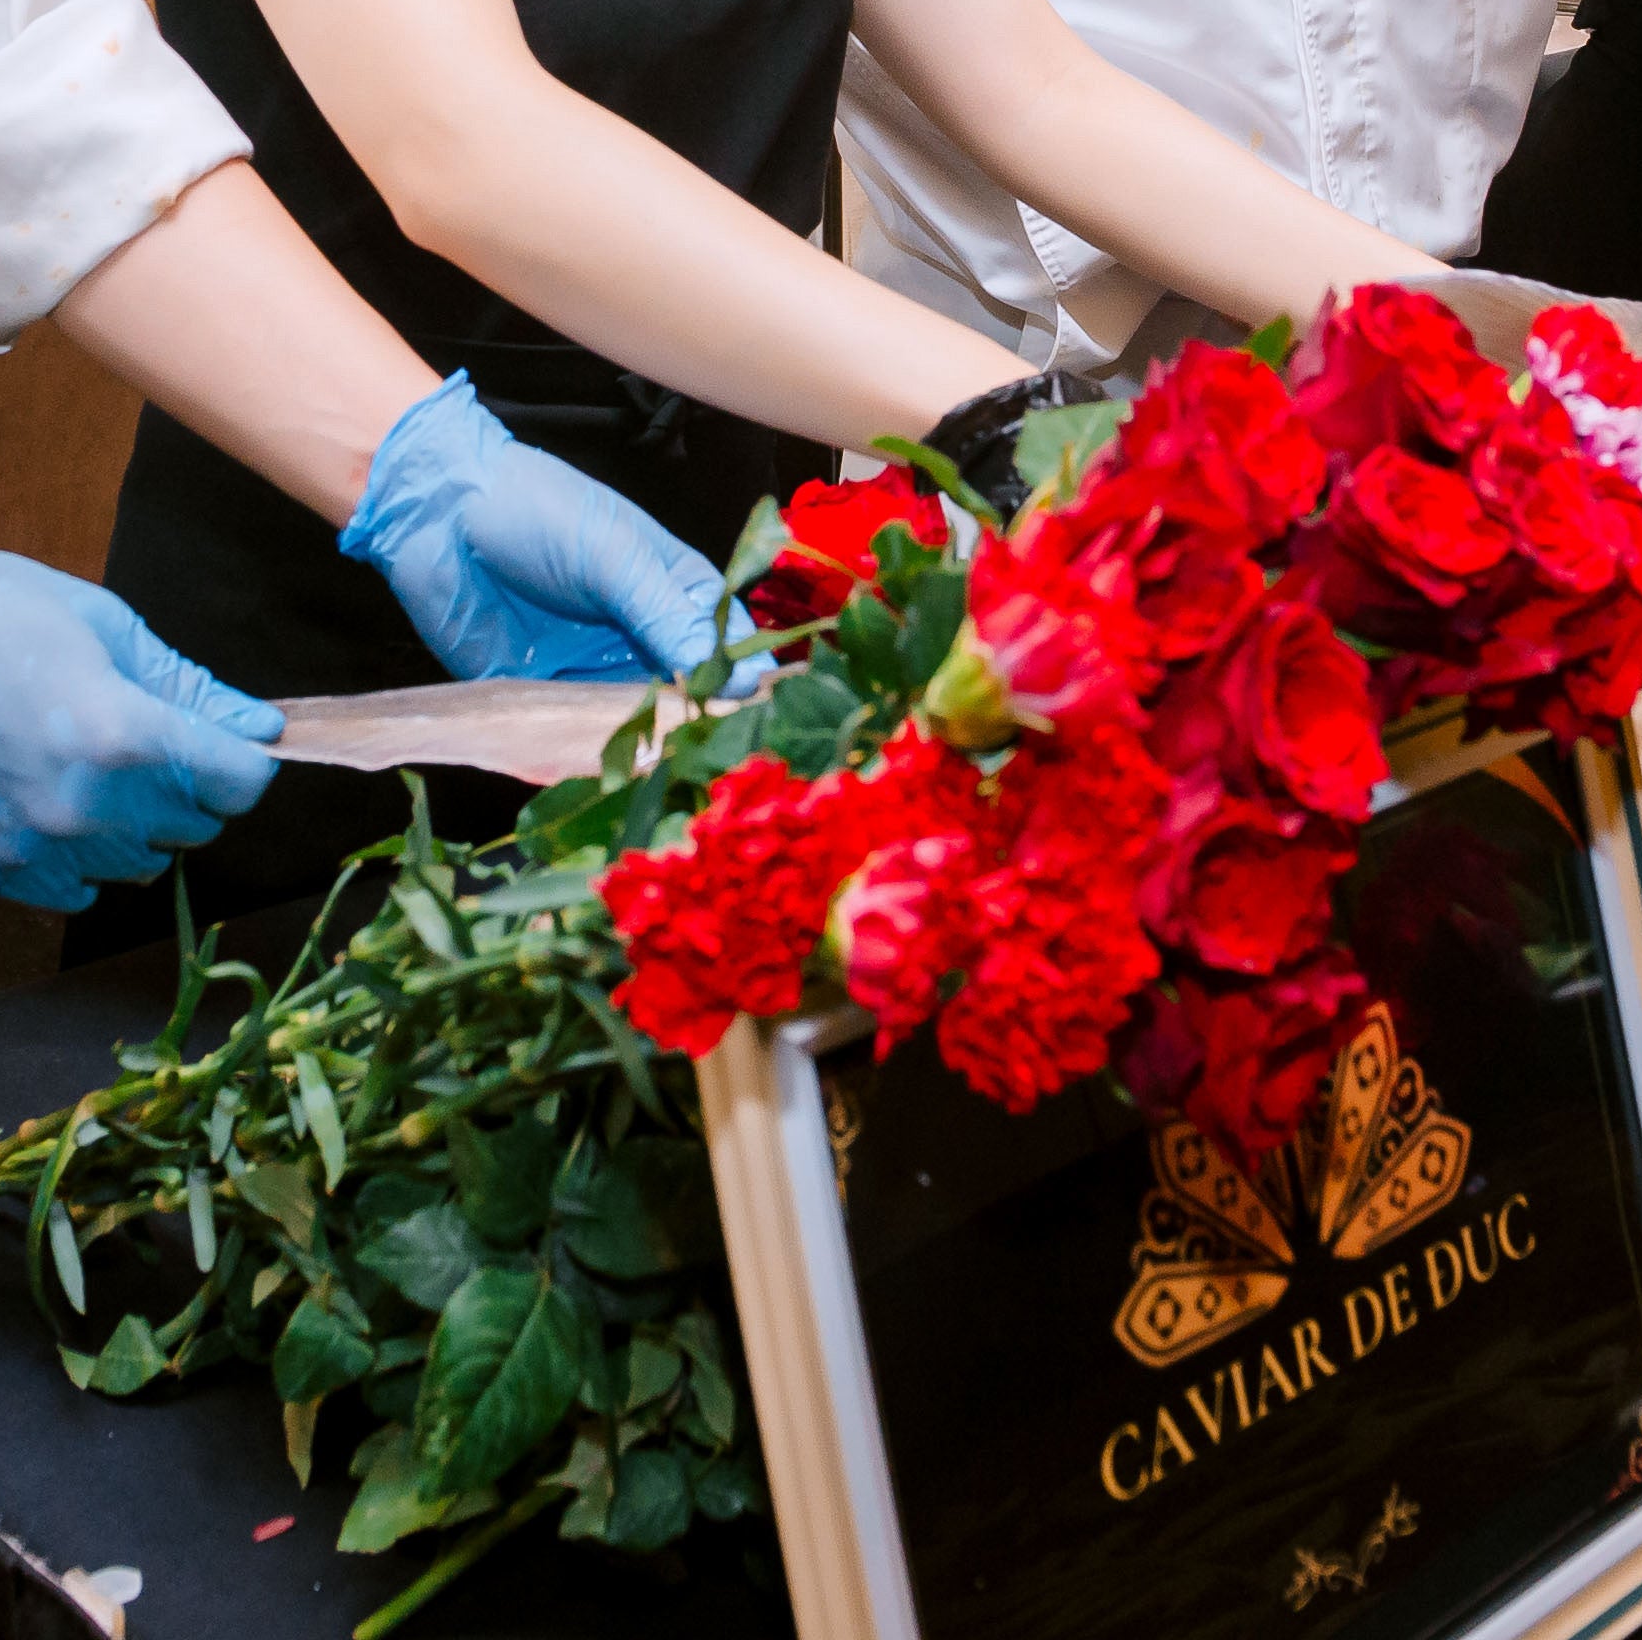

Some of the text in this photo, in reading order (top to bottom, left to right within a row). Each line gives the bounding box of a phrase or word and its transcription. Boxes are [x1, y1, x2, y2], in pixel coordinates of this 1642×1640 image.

[1099, 1192, 1537, 1501] CAVIAR DE DUC
